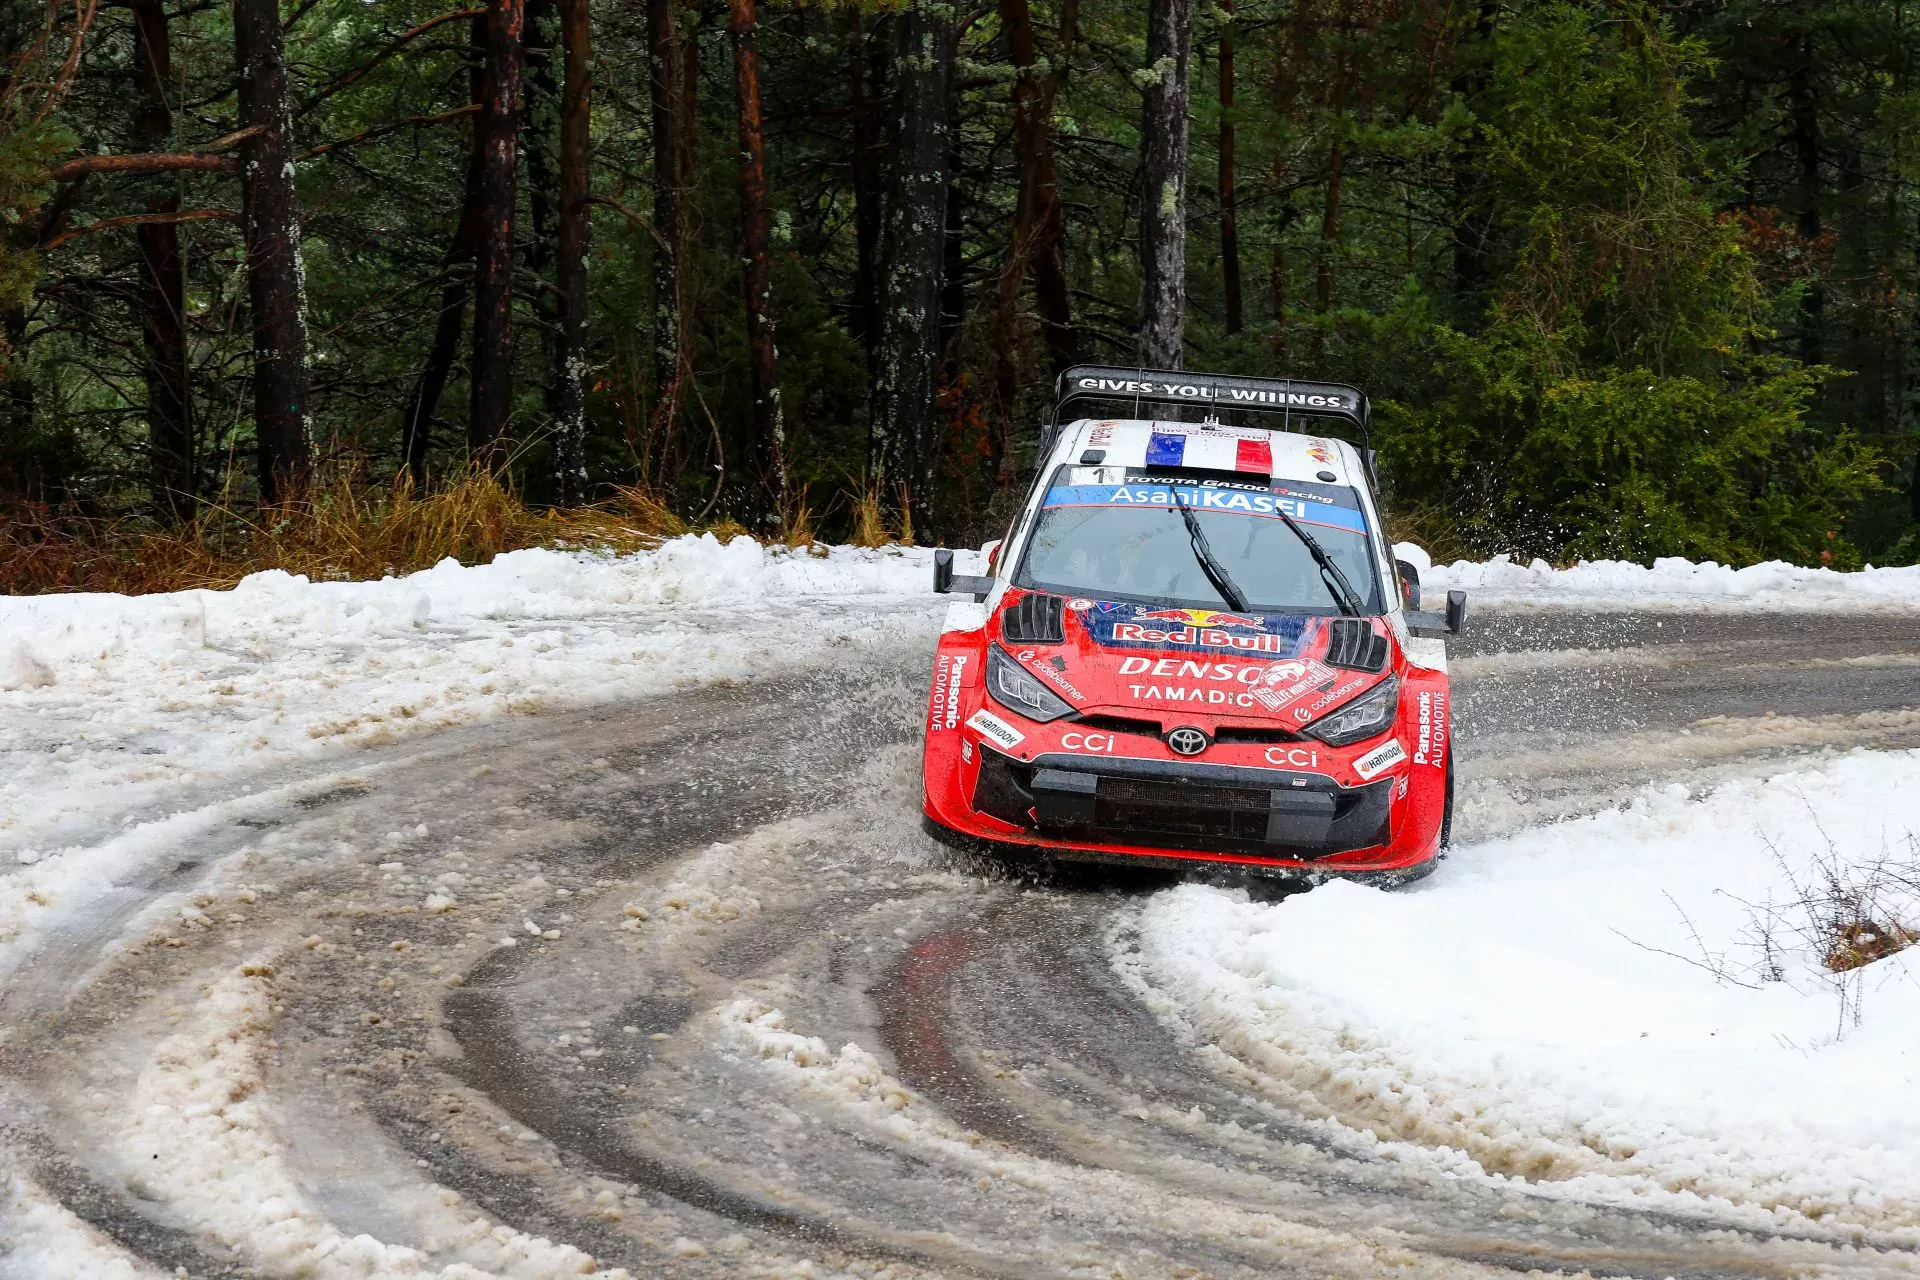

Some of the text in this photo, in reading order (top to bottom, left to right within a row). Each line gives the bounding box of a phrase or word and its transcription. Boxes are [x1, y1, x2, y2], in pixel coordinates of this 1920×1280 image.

[1079, 379, 1153, 393] GIVES
[1163, 384, 1218, 398] YOU
[1092, 468, 1105, 484] 1
[1126, 476, 1335, 504] TOYOTA GAZOO Racing
[1112, 622, 1281, 654] Red Bull
[1031, 659, 1088, 701] codebeamer
[1118, 656, 1266, 685] DENSO
[931, 654, 950, 732] AUTOMOTIVE
[945, 655, 968, 730] Panasonic
[1311, 677, 1366, 711] codebeamer
[1413, 690, 1432, 765] Panasonic
[1432, 690, 1447, 769] AUTOMOTIVE
